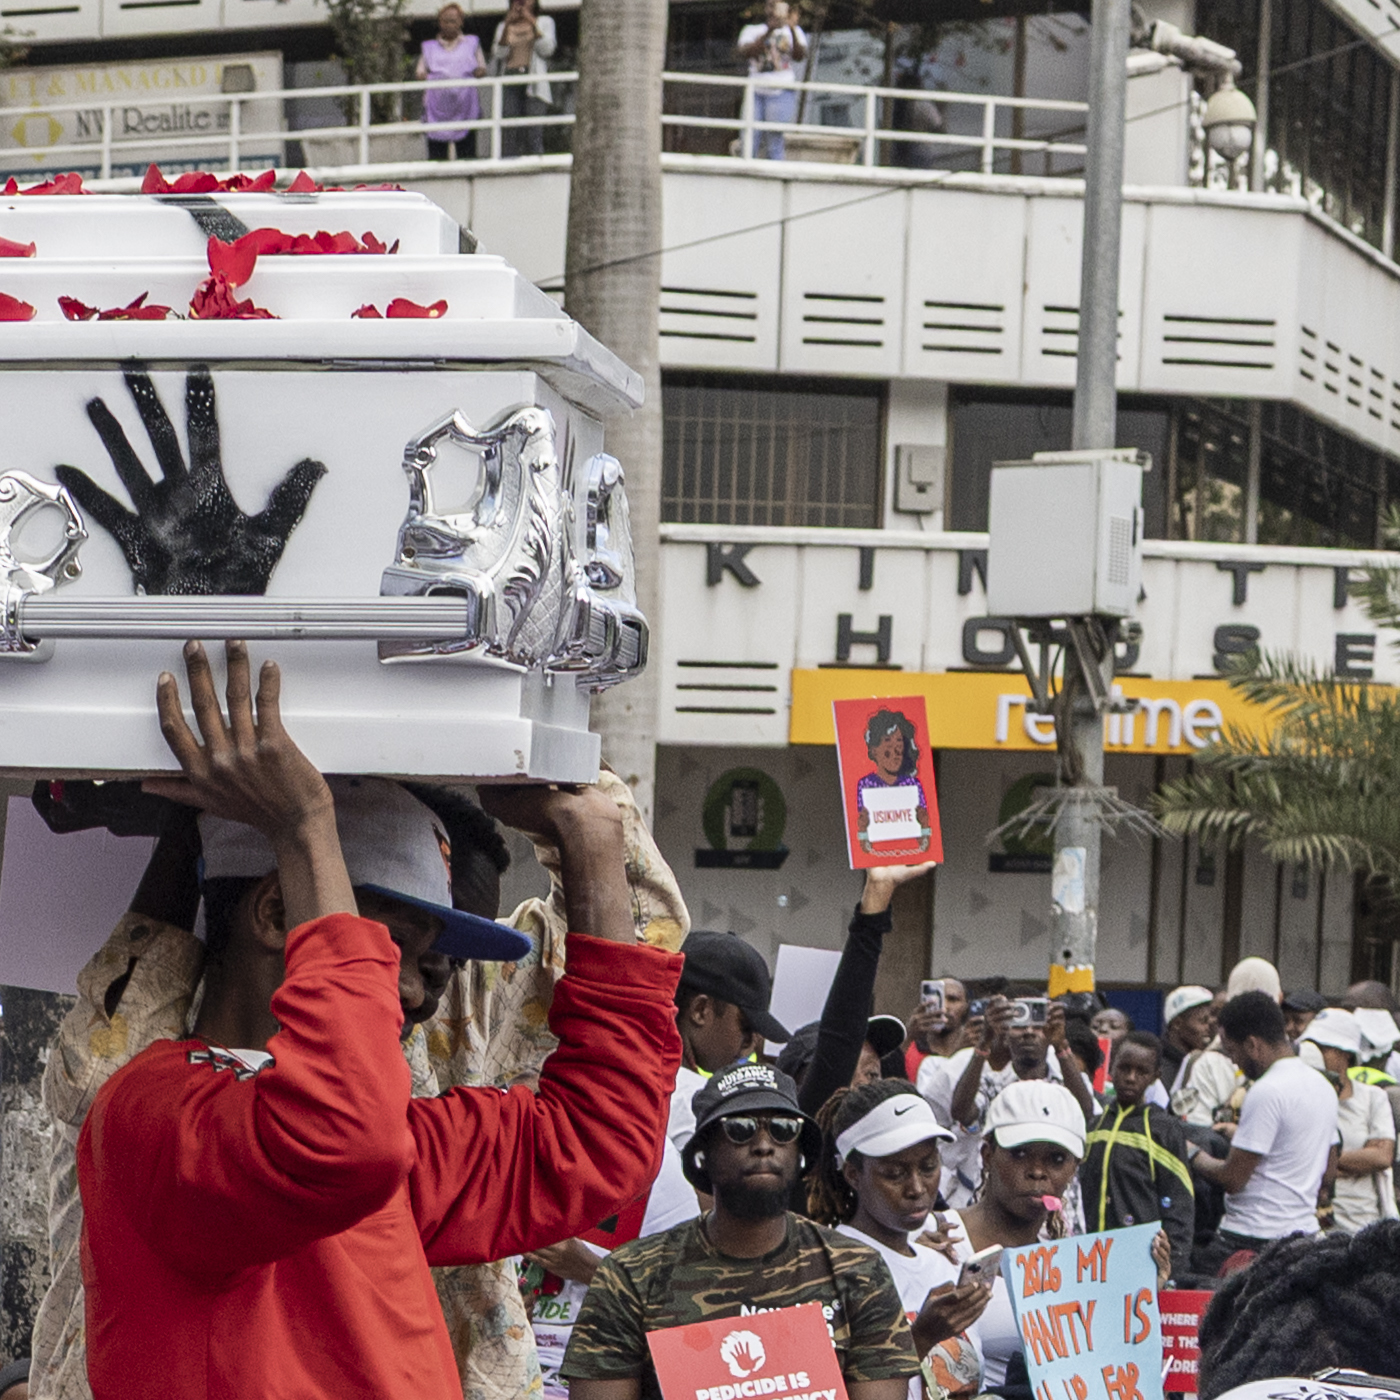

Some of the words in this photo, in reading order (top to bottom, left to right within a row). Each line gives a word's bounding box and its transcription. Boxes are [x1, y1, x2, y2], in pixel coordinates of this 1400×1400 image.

[122, 107, 211, 134] Realite
[995, 684, 1224, 749] relme
[873, 807, 914, 827] USIKIMYE
[1076, 1237, 1114, 1284] MY
[1124, 1286, 1153, 1346] IS
[1160, 1313, 1199, 1327] WHERE
[1162, 1335, 1175, 1348] RE
[788, 1370, 811, 1390] IS
